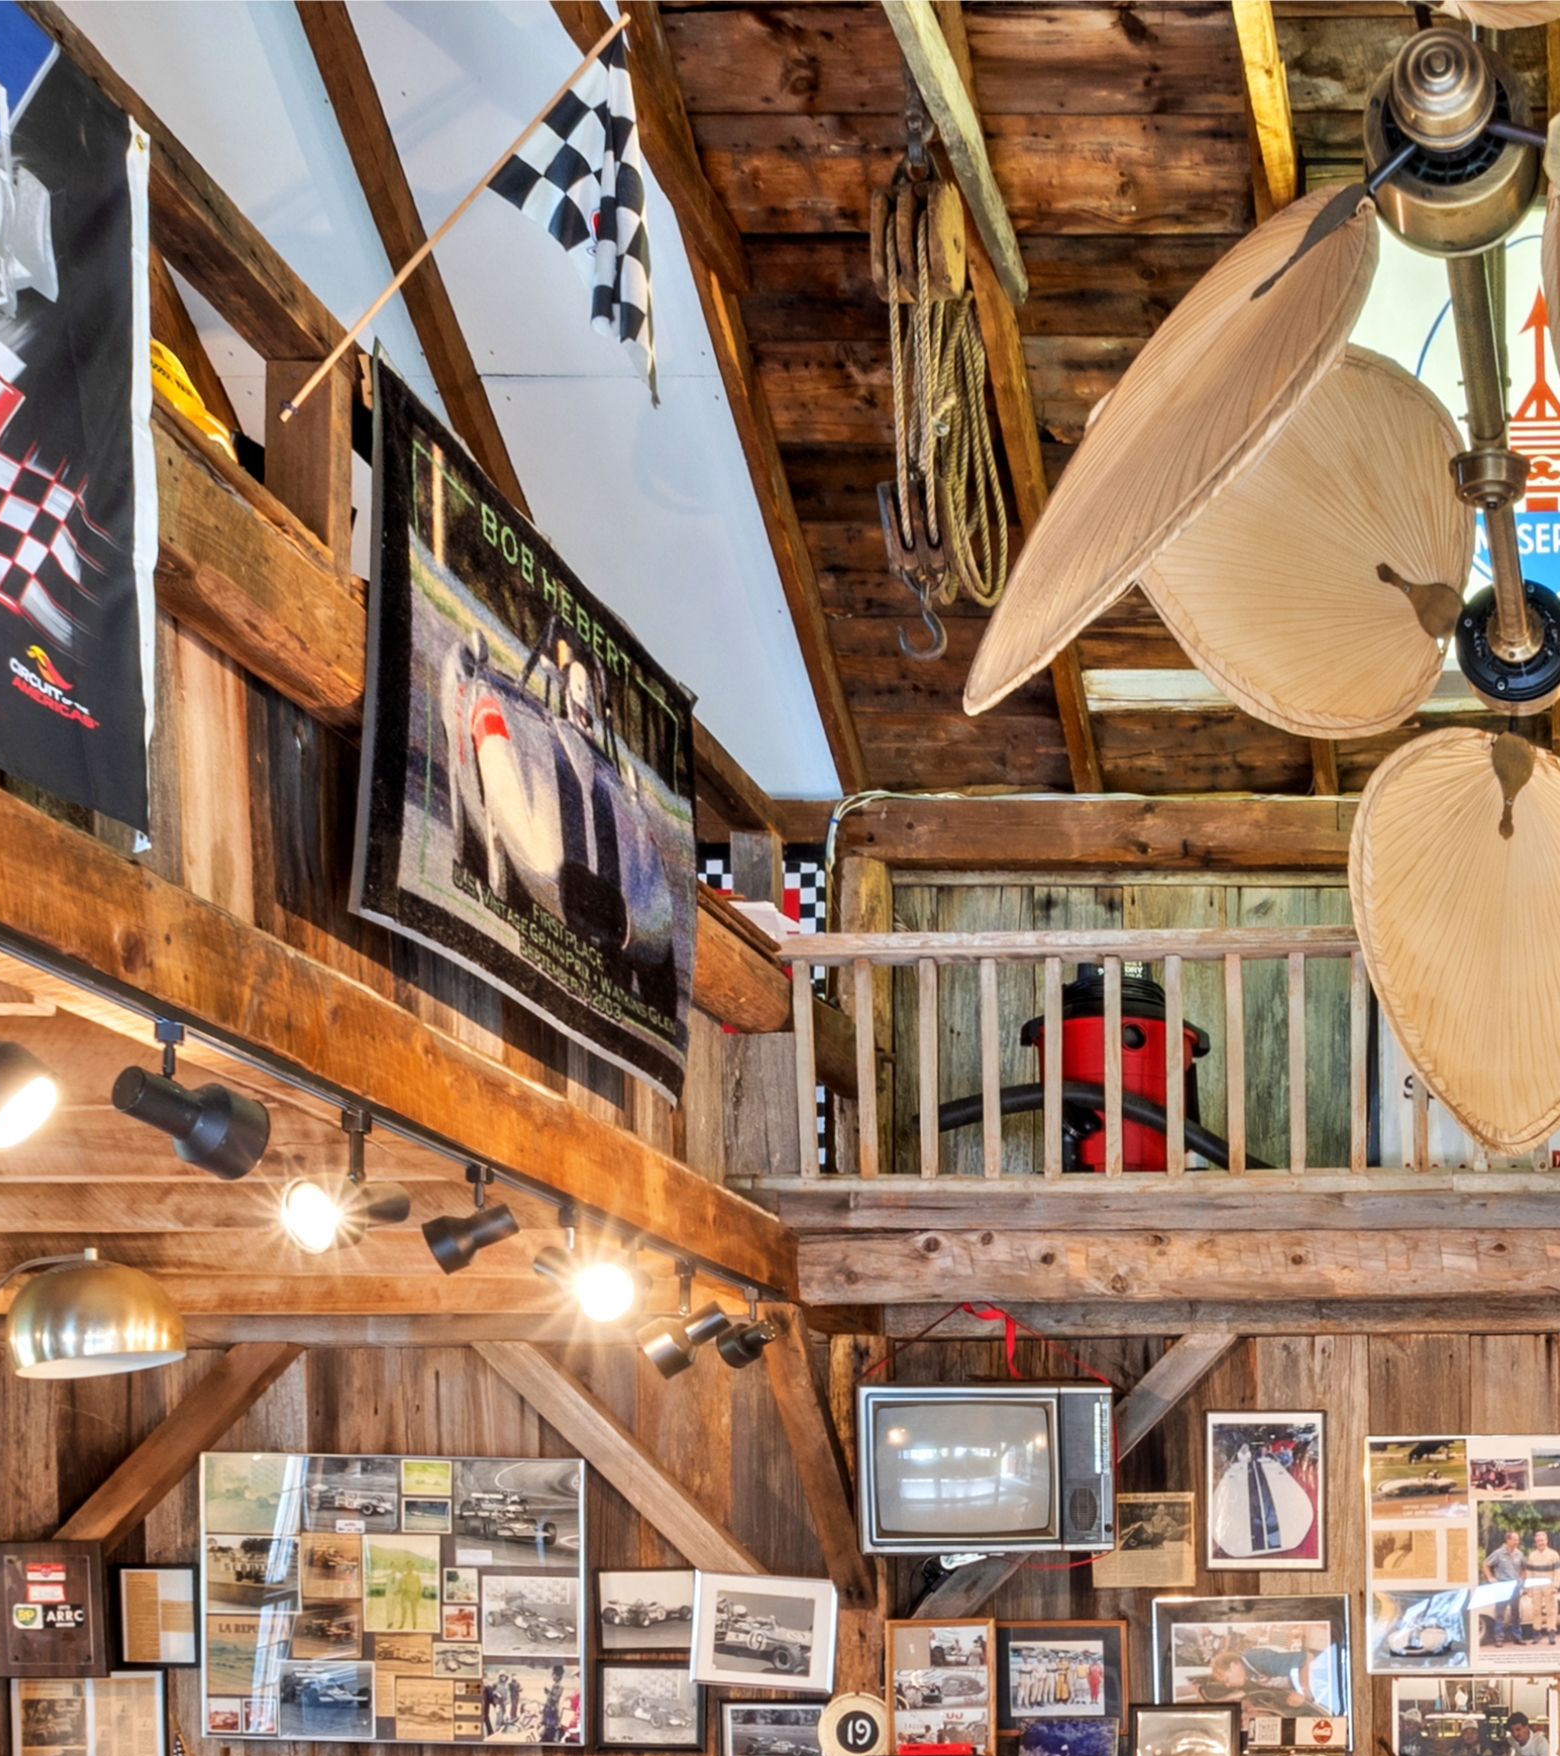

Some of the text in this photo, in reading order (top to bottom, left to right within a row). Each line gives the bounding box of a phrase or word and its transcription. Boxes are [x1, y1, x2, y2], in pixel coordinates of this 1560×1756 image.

[481, 502, 632, 686] BOB HEBERT
[9, 656, 64, 701] CIRCUIT
[12, 675, 101, 730] AMERICAS
[17, 1608, 36, 1622] BP
[46, 1609, 84, 1623] ARRC
[846, 1718, 872, 1746] 19
